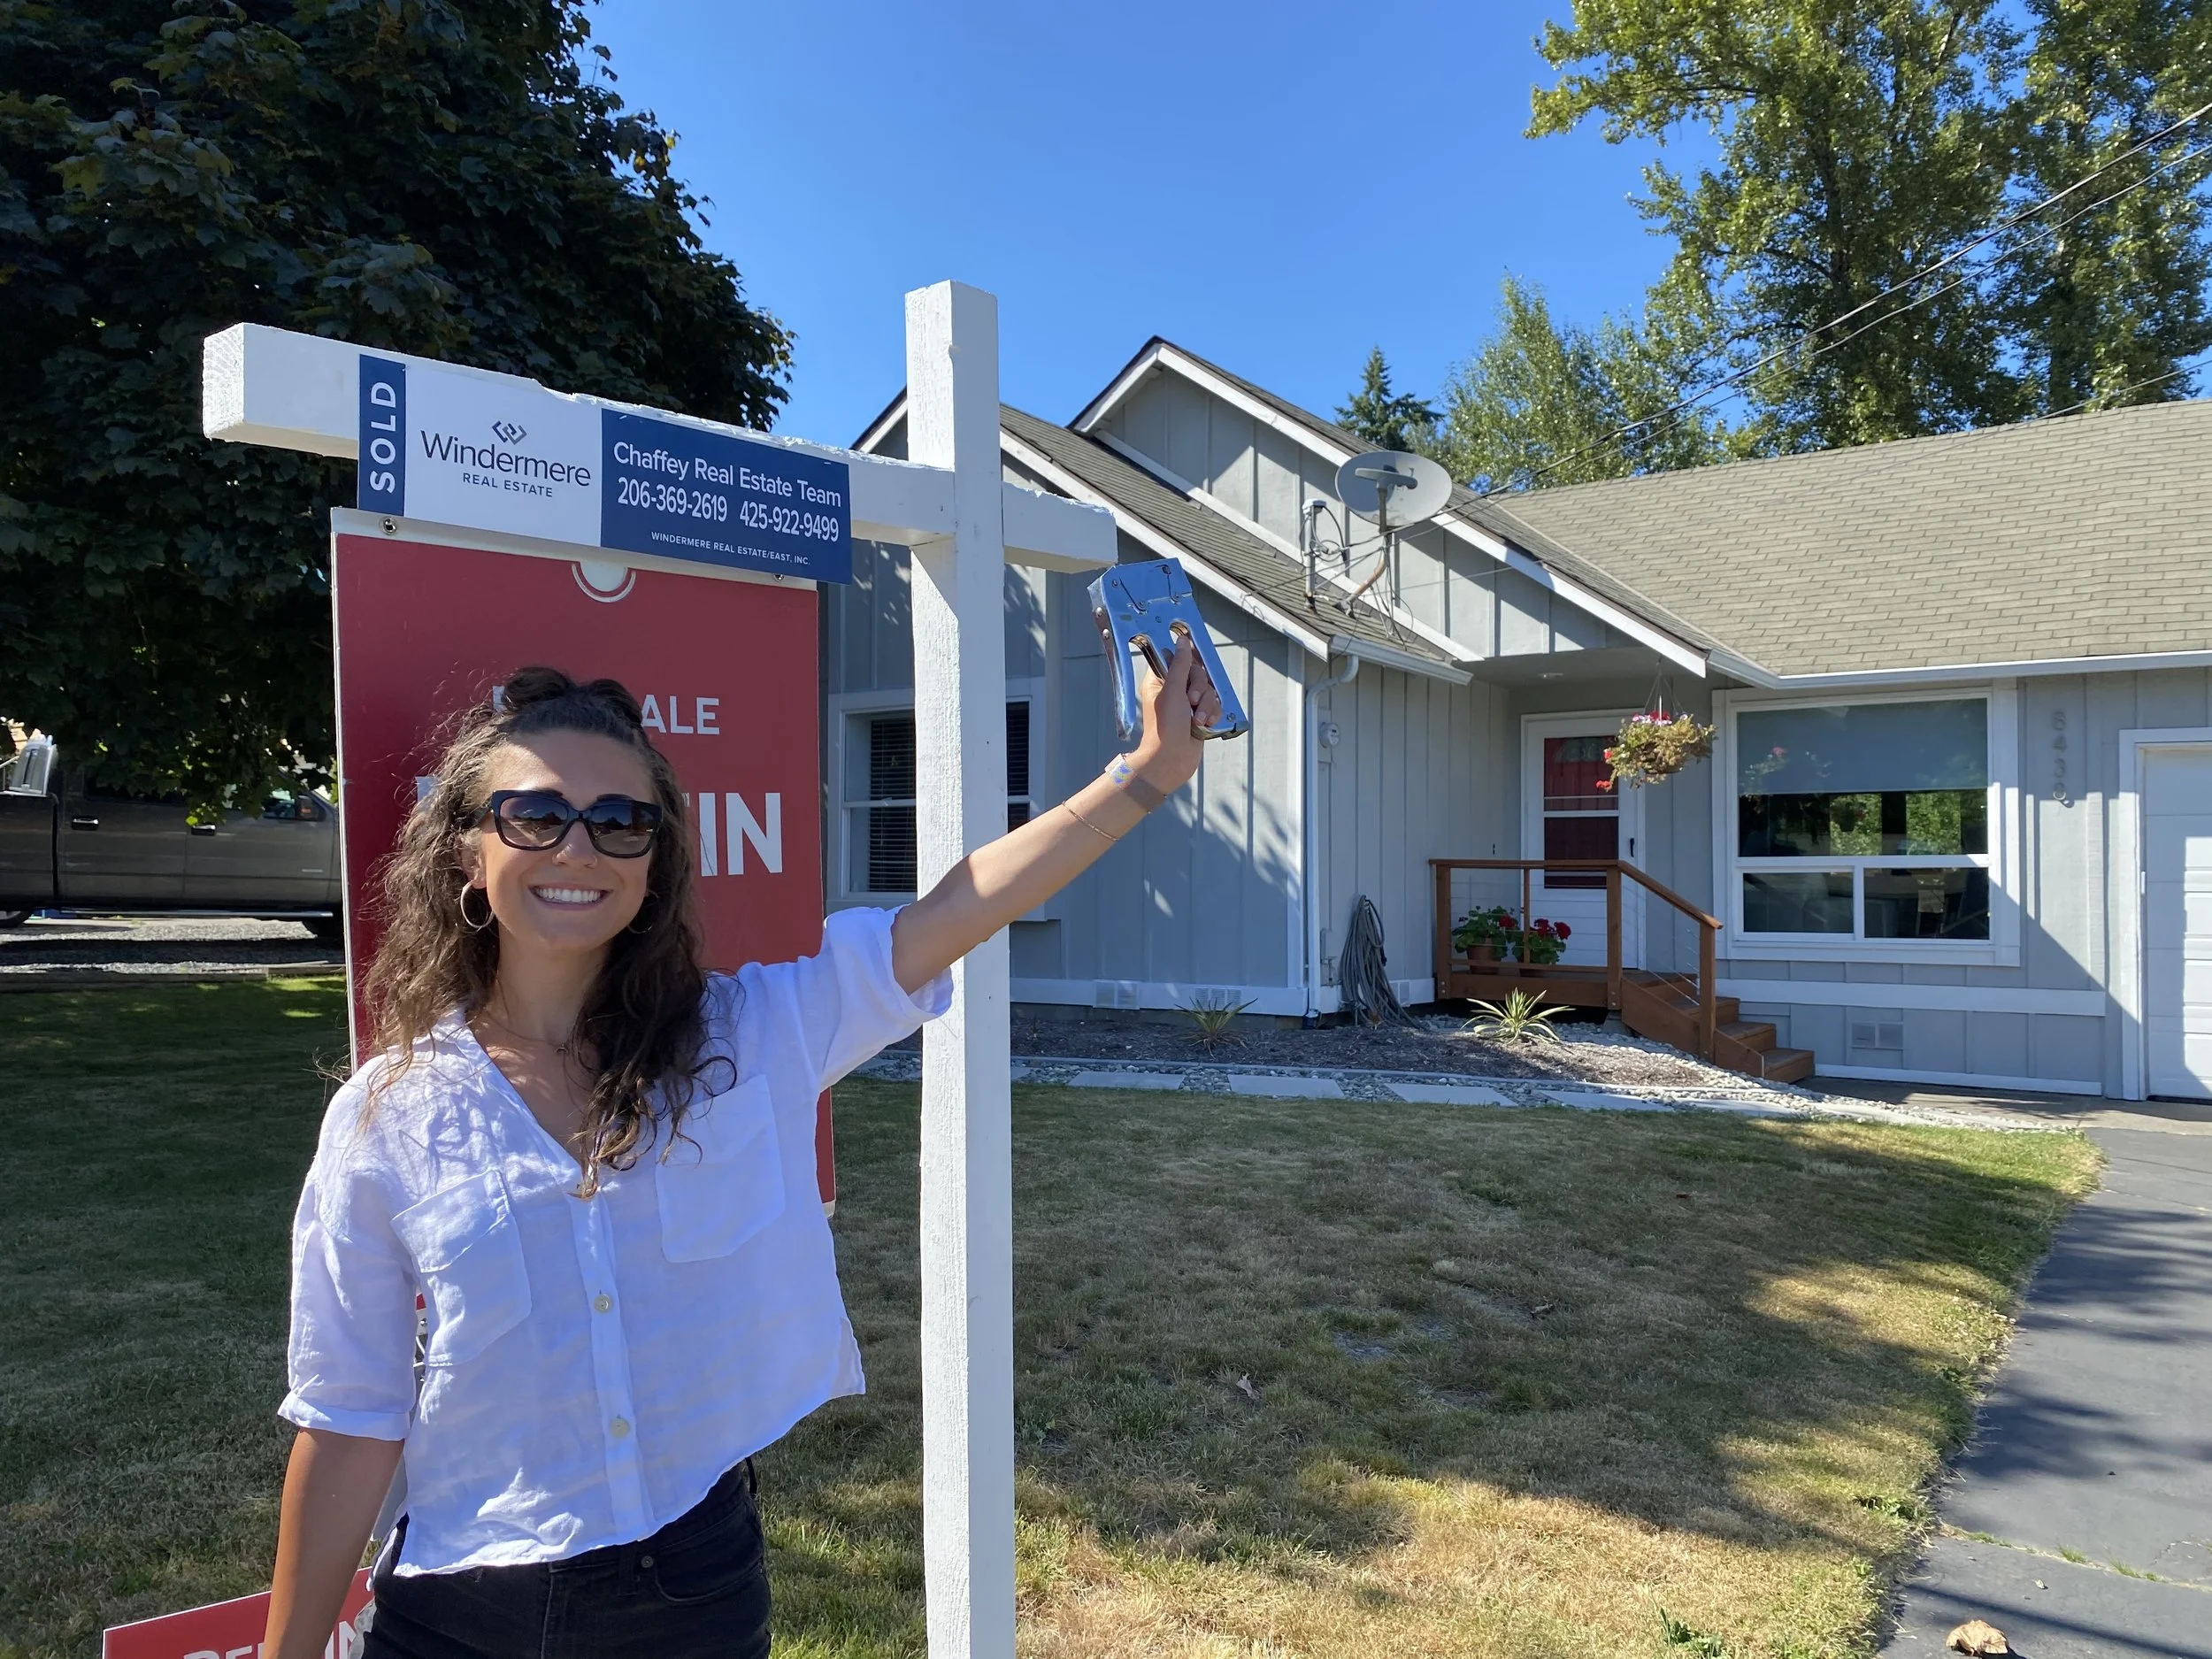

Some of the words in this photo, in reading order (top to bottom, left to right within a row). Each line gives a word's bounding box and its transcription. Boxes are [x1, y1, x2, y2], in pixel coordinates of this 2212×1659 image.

[370, 381, 396, 494] SOLD
[420, 430, 591, 487] Windermere
[463, 472, 498, 488] REAL
[503, 480, 553, 497] ESTATE
[613, 442, 690, 480] Chaffey
[695, 457, 733, 486] Real
[740, 467, 793, 497] Estate
[796, 480, 841, 507] Team
[618, 477, 728, 522] 206-369-2619
[739, 501, 840, 542] 425-922-9499
[651, 531, 711, 549] WINDERMERE
[713, 542, 734, 553] REAL
[737, 546, 793, 563] ESTATE/EAST,
[794, 555, 810, 565] INC.
[641, 694, 720, 735] ALE
